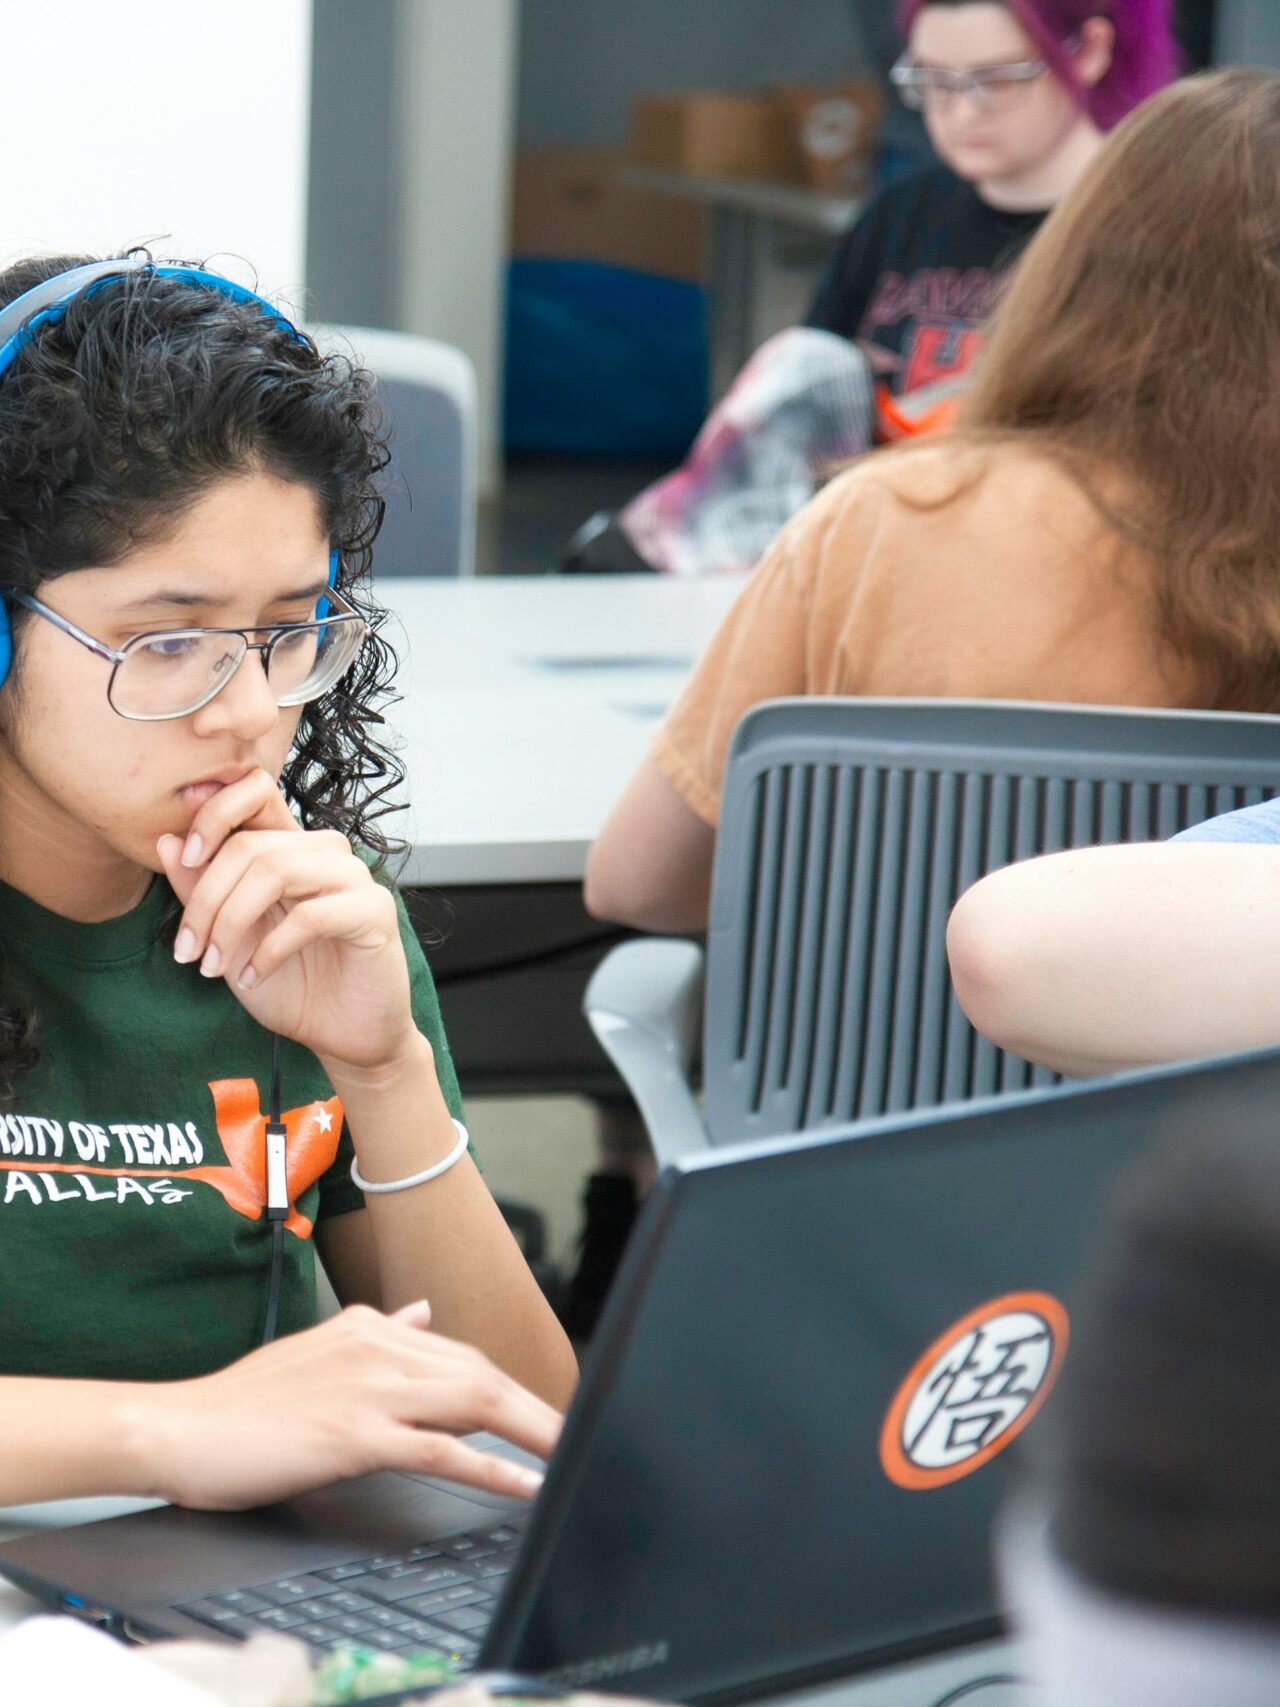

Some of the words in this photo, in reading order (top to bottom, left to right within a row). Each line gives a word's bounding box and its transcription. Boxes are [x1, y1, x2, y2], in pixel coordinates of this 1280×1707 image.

[68, 1121, 111, 1162] OF
[108, 1121, 204, 1165] TEXAS
[906, 1330, 1051, 1456] 悟
